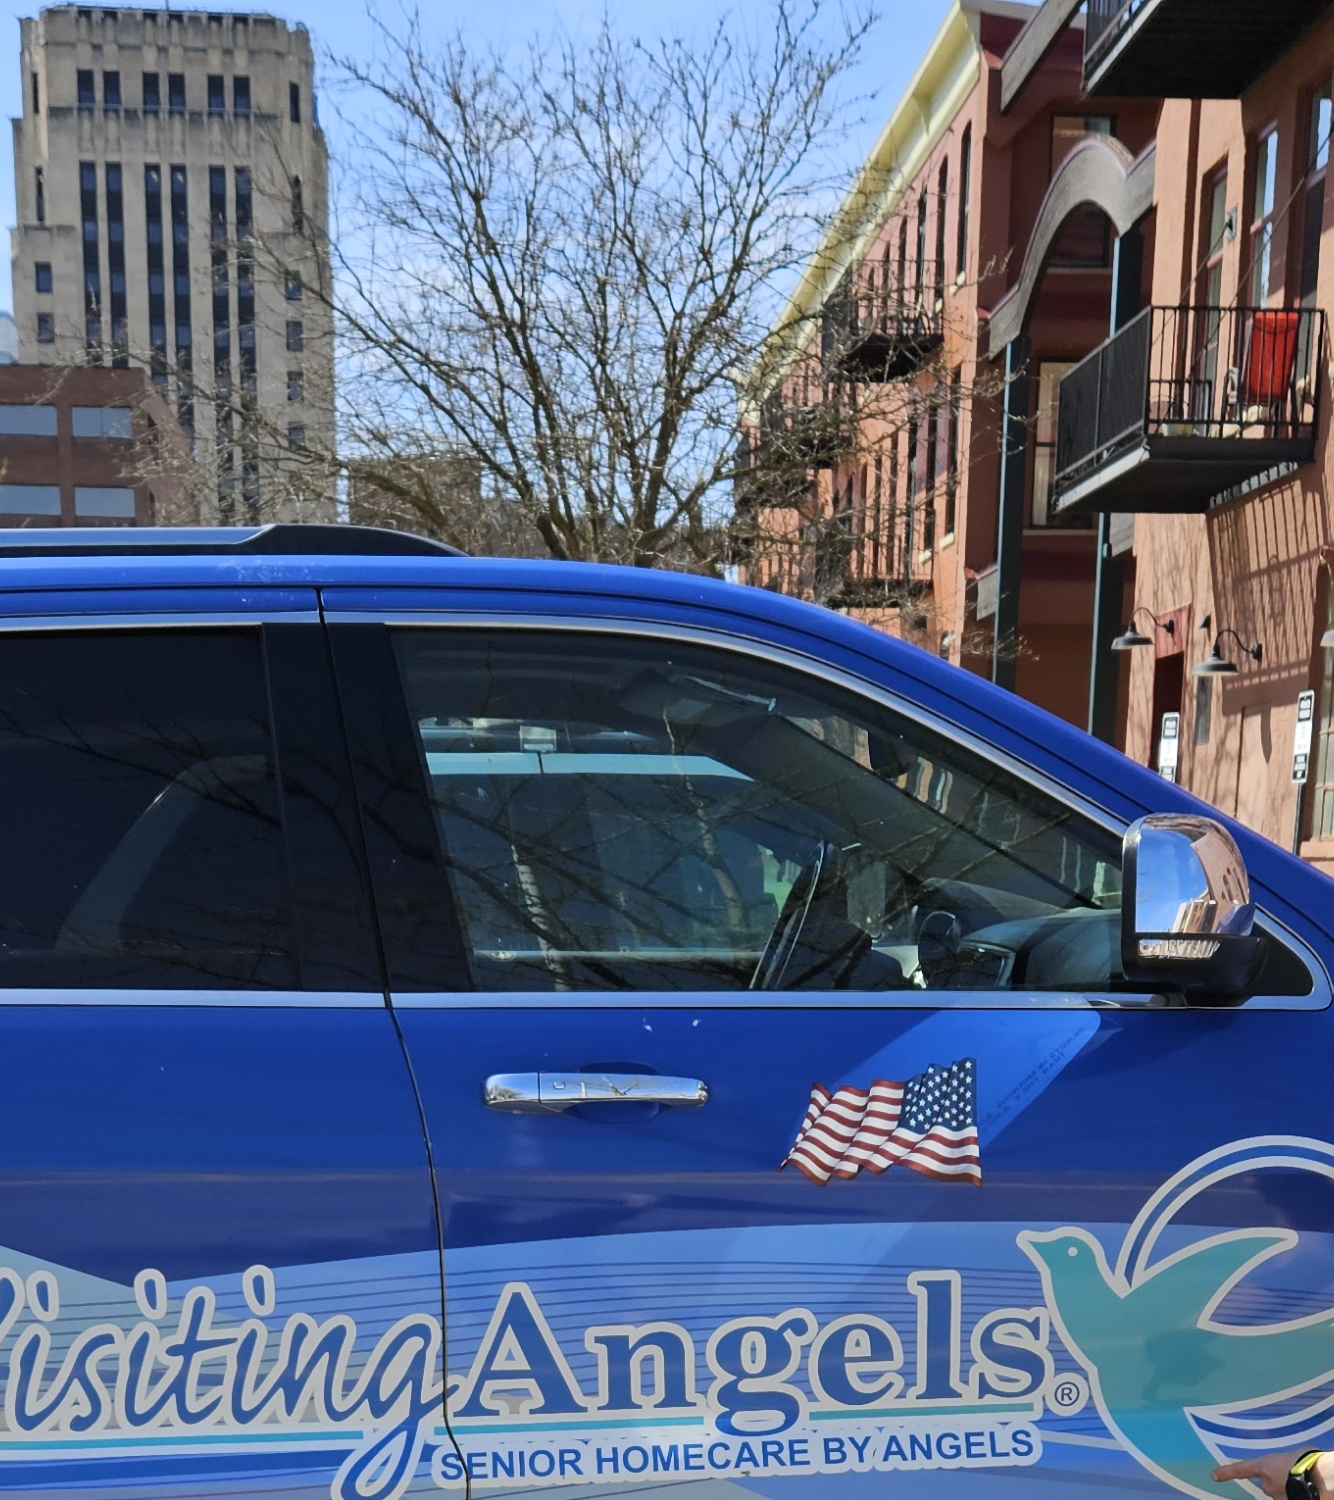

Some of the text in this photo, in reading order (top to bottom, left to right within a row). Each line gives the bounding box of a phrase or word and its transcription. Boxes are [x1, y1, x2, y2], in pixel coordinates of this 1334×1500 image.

[439, 1428, 1035, 1482] SENIOR HOMECARE BY ANGELS
